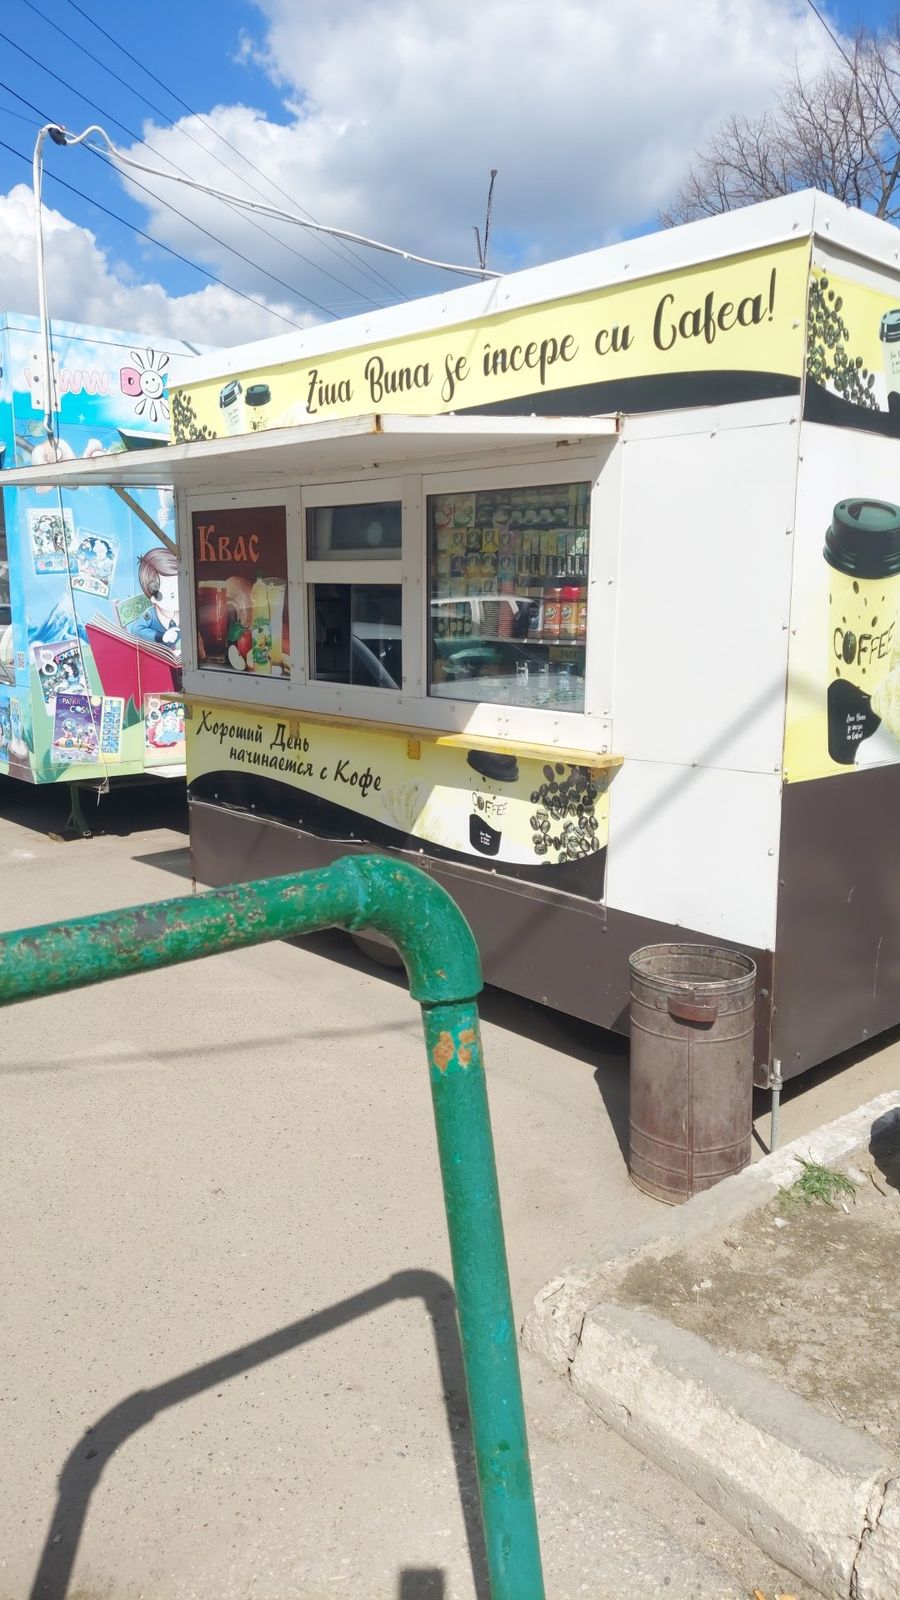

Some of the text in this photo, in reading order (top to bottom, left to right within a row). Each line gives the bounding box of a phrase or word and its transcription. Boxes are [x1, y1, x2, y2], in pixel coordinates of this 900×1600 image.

[305, 369, 354, 414] Ziua
[364, 355, 434, 403] Buna
[594, 322, 635, 356] cu
[652, 267, 777, 351] Cafea!
[197, 524, 260, 563] Квас
[196, 710, 310, 752] Хороший День
[229, 746, 382, 798] начинается с Кофе
